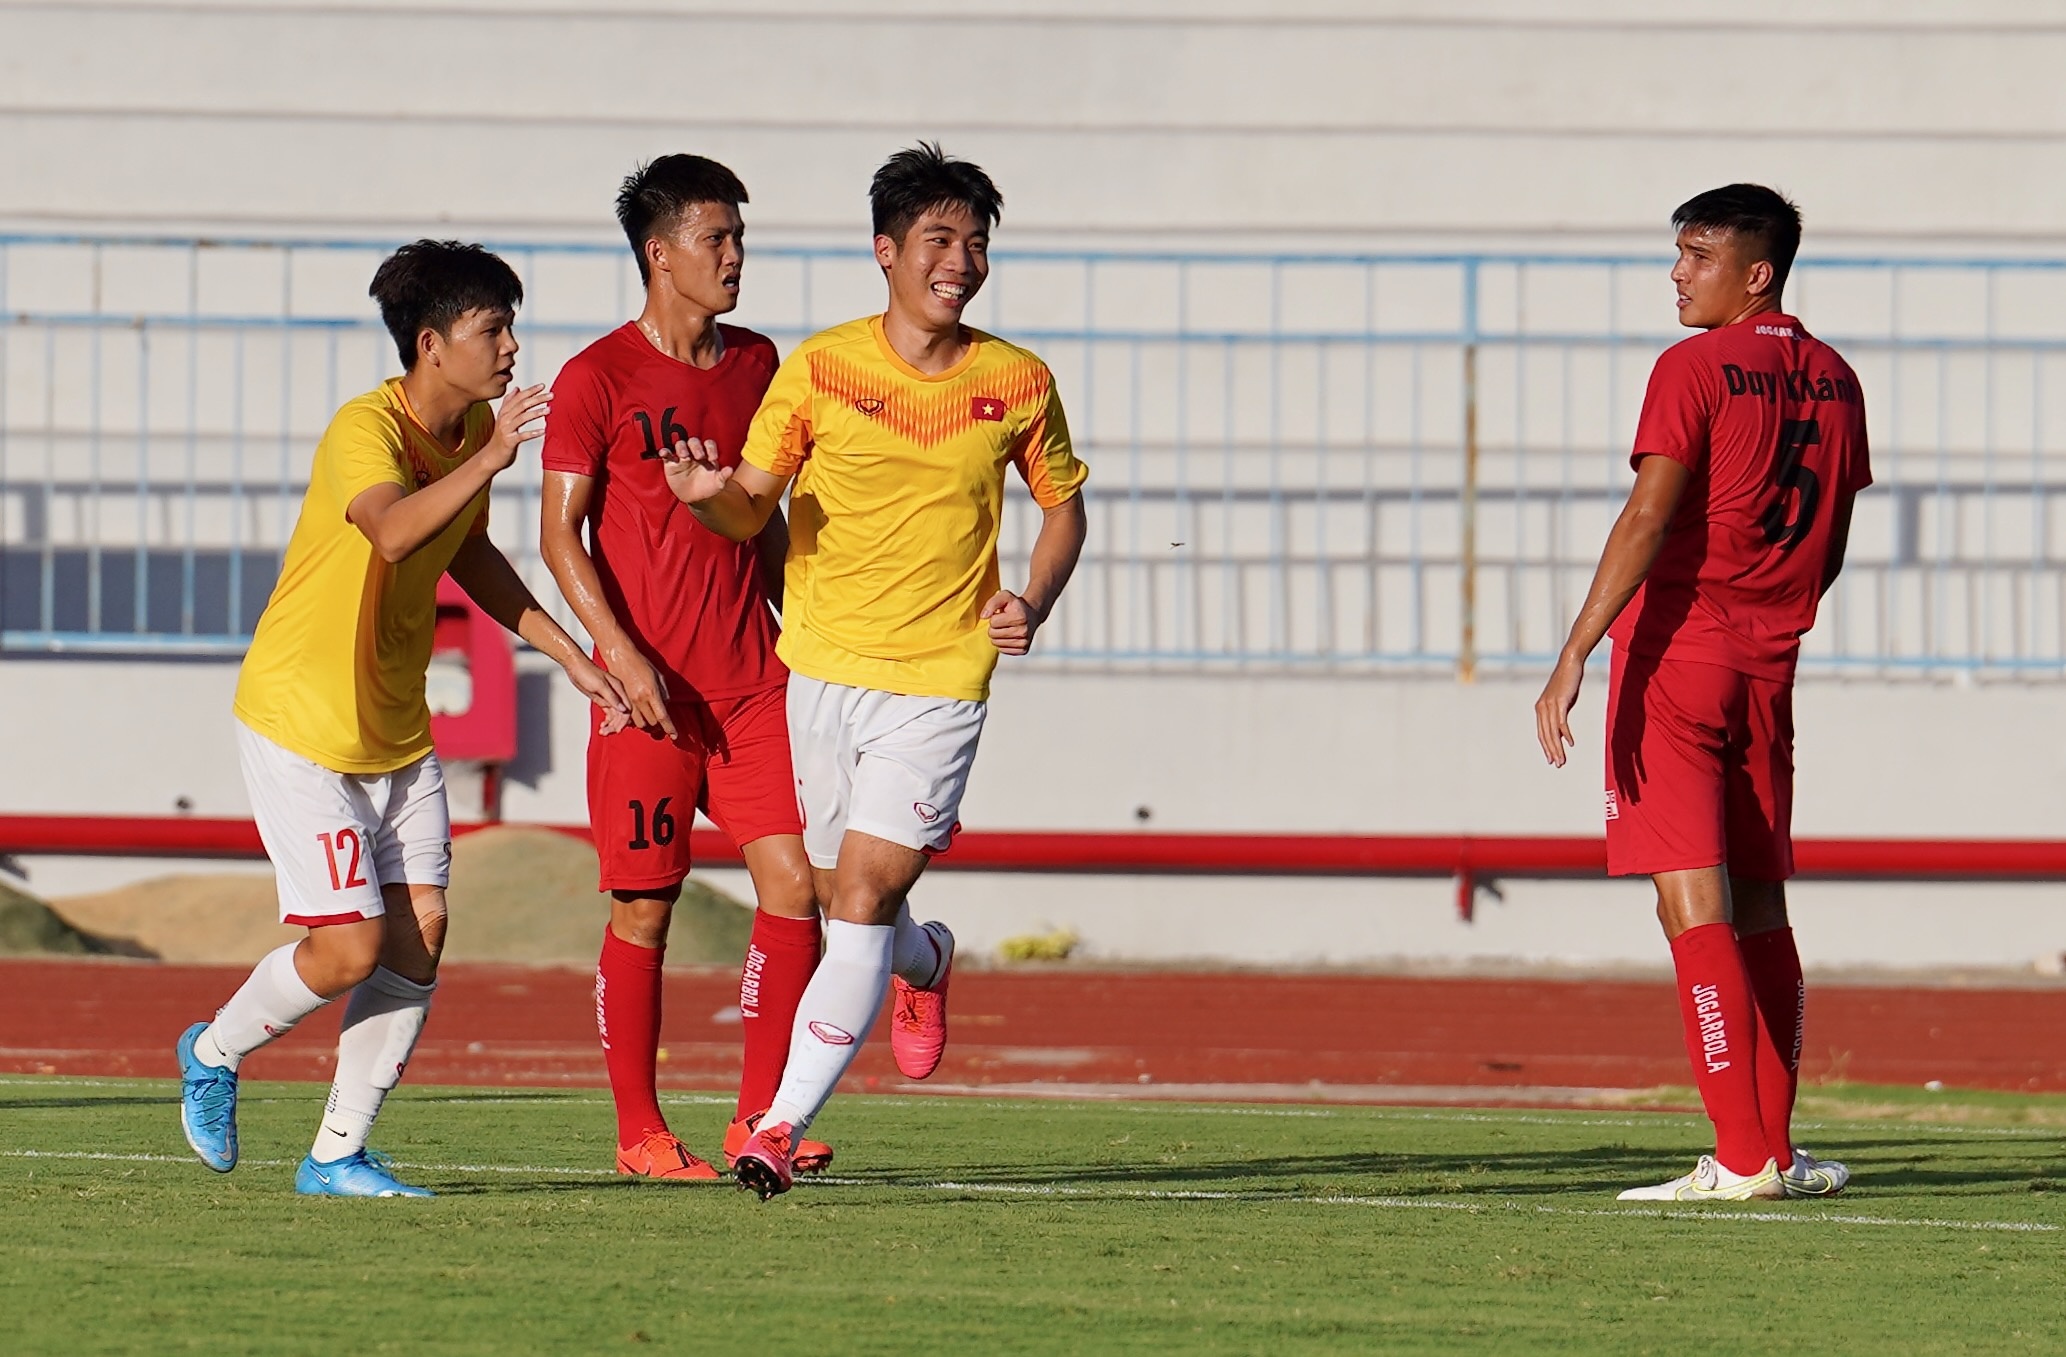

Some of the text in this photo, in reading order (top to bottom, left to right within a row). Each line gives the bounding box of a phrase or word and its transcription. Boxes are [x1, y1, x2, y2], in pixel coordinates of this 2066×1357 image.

[1721, 364, 1777, 405] Duy
[634, 406, 689, 459] 16
[1763, 418, 1820, 551] 5
[629, 796, 674, 849] 16
[316, 828, 368, 890] 12
[740, 944, 767, 1018] JOGARBOLA
[1691, 984, 1731, 1074] JOGARBOLA
